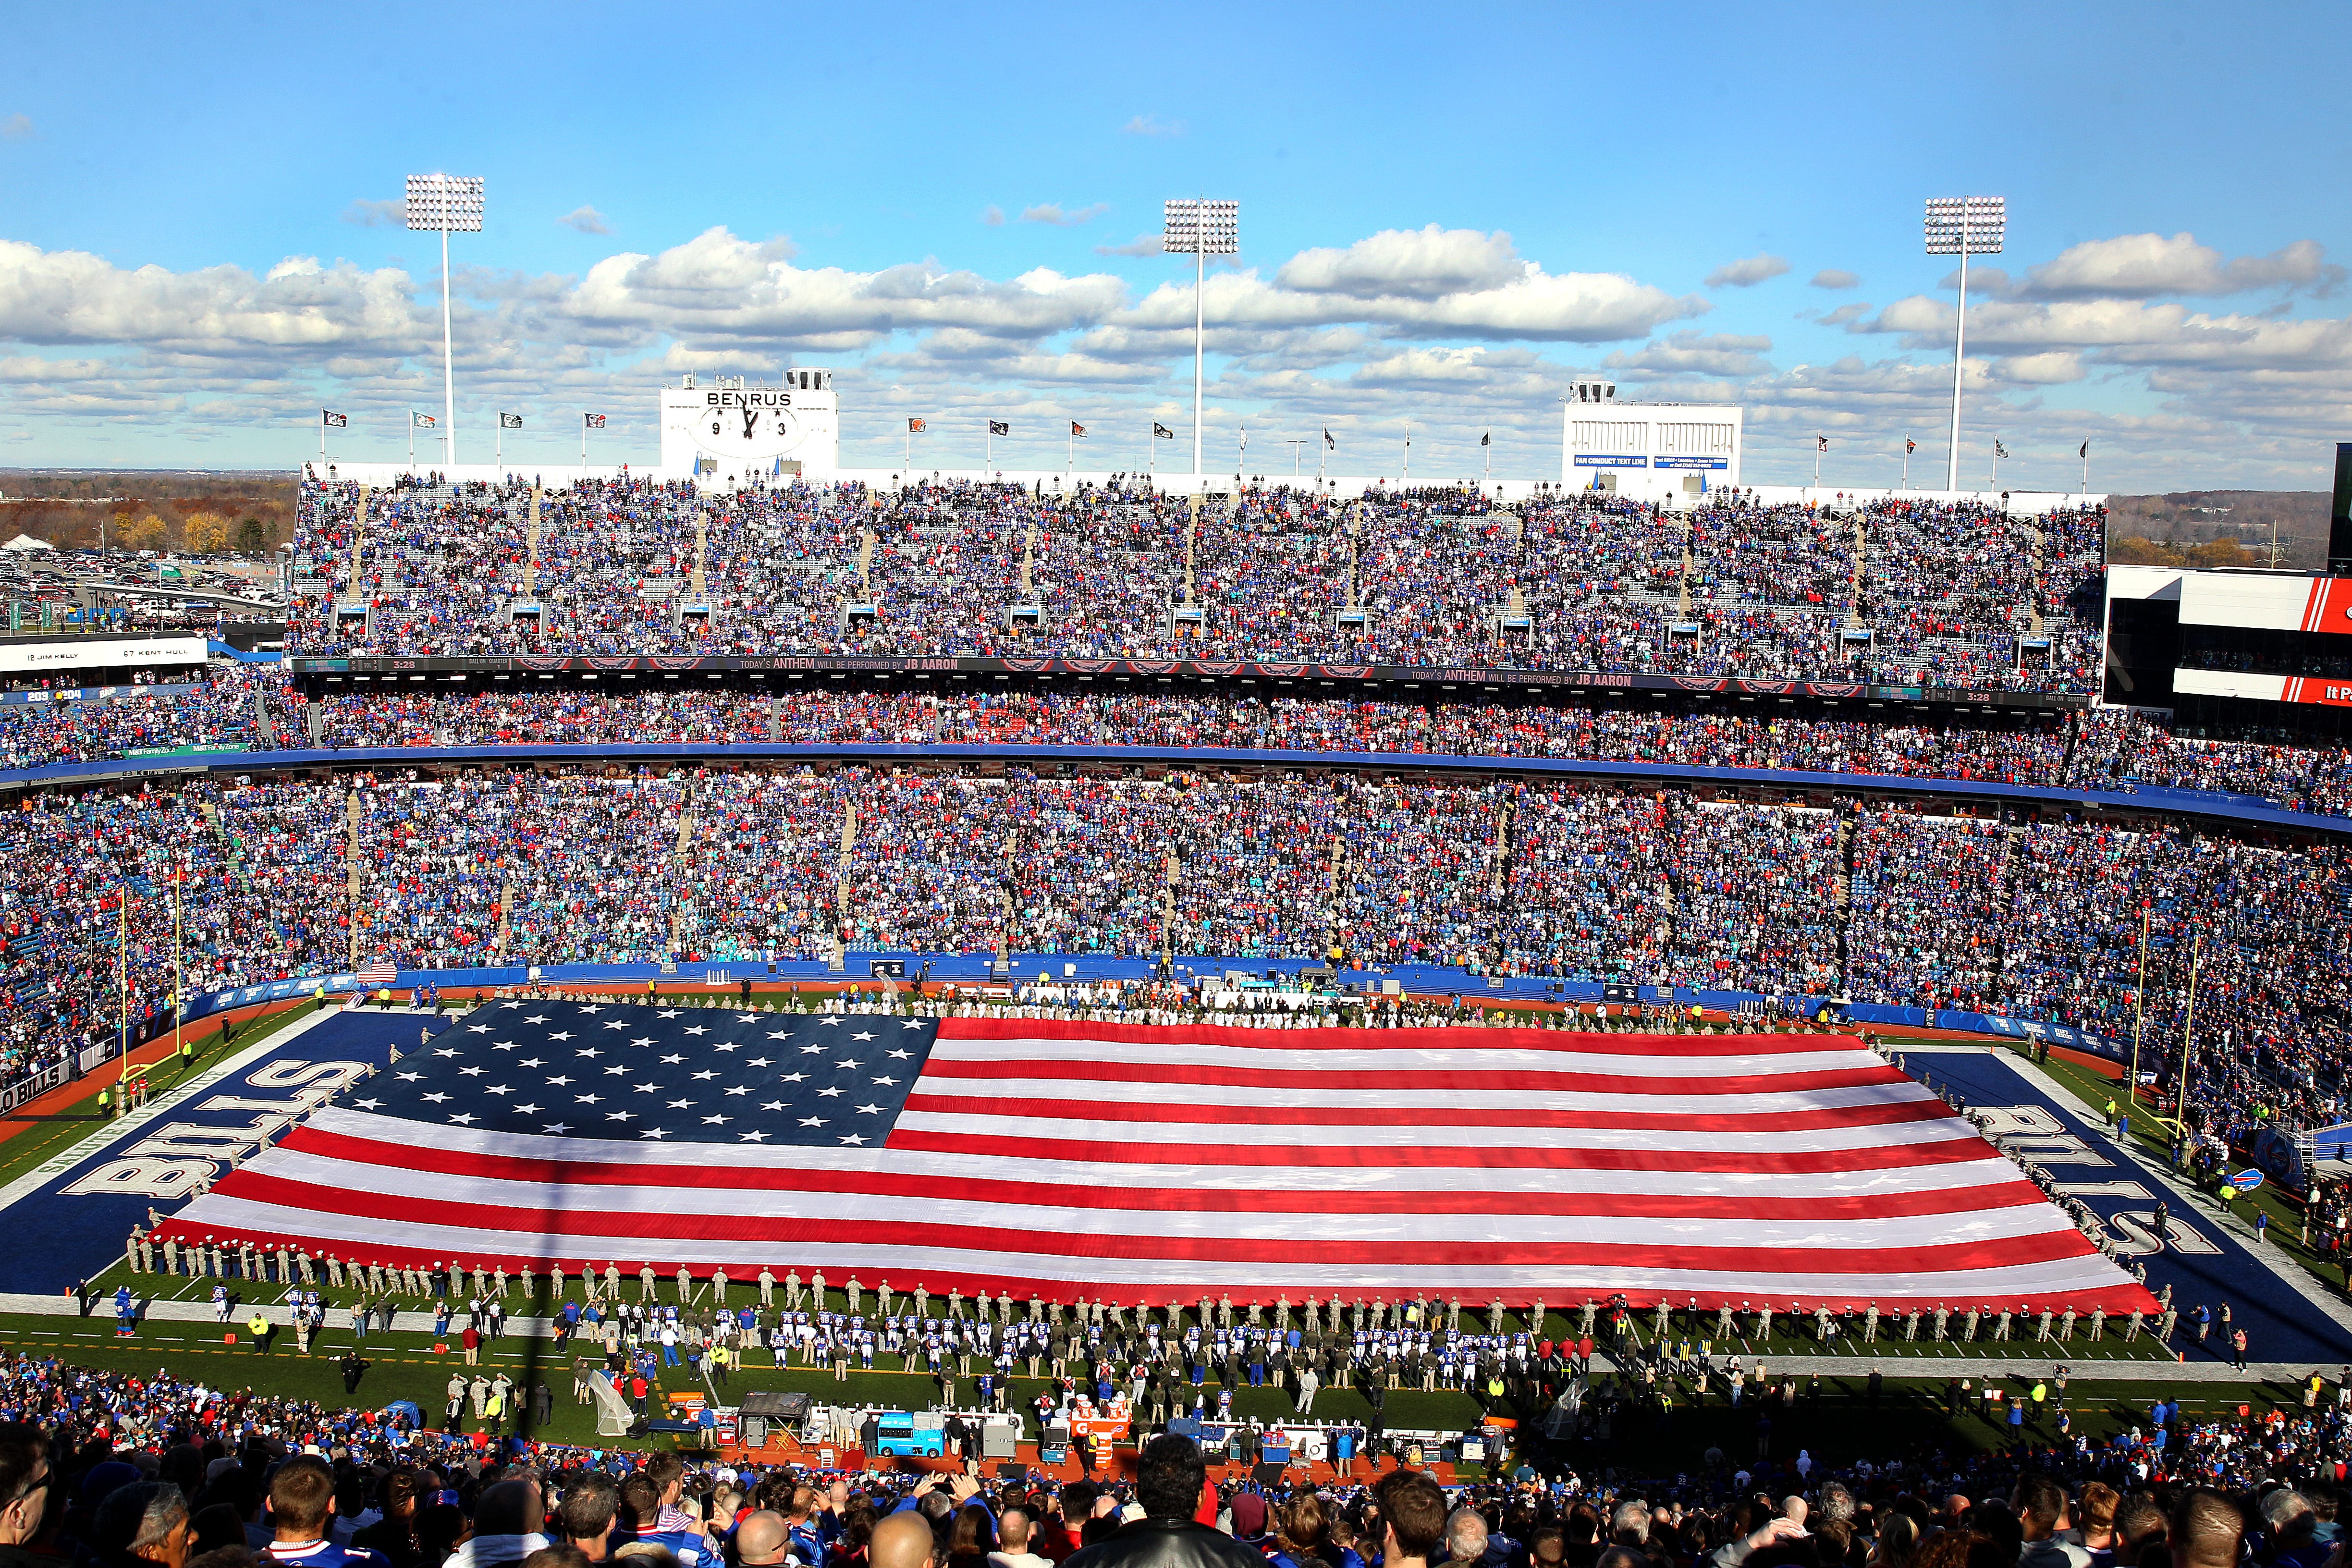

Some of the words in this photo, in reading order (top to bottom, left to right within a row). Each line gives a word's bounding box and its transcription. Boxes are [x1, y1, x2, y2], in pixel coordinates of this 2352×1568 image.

[708, 393, 791, 406] BENRUS
[712, 422, 720, 434] 9
[778, 423, 785, 435] 3
[393, 661, 416, 669] 3:28
[740, 658, 771, 669] TODAY'S
[773, 658, 815, 669] ANTHEM
[818, 661, 833, 669] WILL
[836, 661, 845, 669] BE
[848, 661, 890, 669] PERFORMED
[892, 661, 901, 669] BY
[904, 659, 919, 669] JB
[921, 659, 958, 670] AARON
[1412, 669, 1442, 680] TODAY'S
[1444, 670, 1486, 681] ANTHEM
[1488, 674, 1504, 682] WILL
[1507, 674, 1517, 683] BE
[1519, 674, 1561, 684] PERFORMED
[1576, 674, 1590, 686] JB
[1593, 675, 1631, 686] AARON
[27, 691, 49, 702] 203
[63, 689, 82, 700] 204
[99, 688, 116, 699] Blue
[131, 686, 148, 697] Blue
[1967, 693, 1990, 701] 3:28
[2326, 686, 2338, 699] It
[17, 1066, 60, 1104] BILLS
[38, 1127, 126, 1173] SALUTE
[117, 1112, 154, 1125] TO
[155, 1070, 228, 1109] SERVICE
[56, 1059, 370, 1200] BILLS
[1220, 1395, 1230, 1403] 25
[690, 1411, 699, 1421] G
[1076, 1423, 1088, 1434] G
